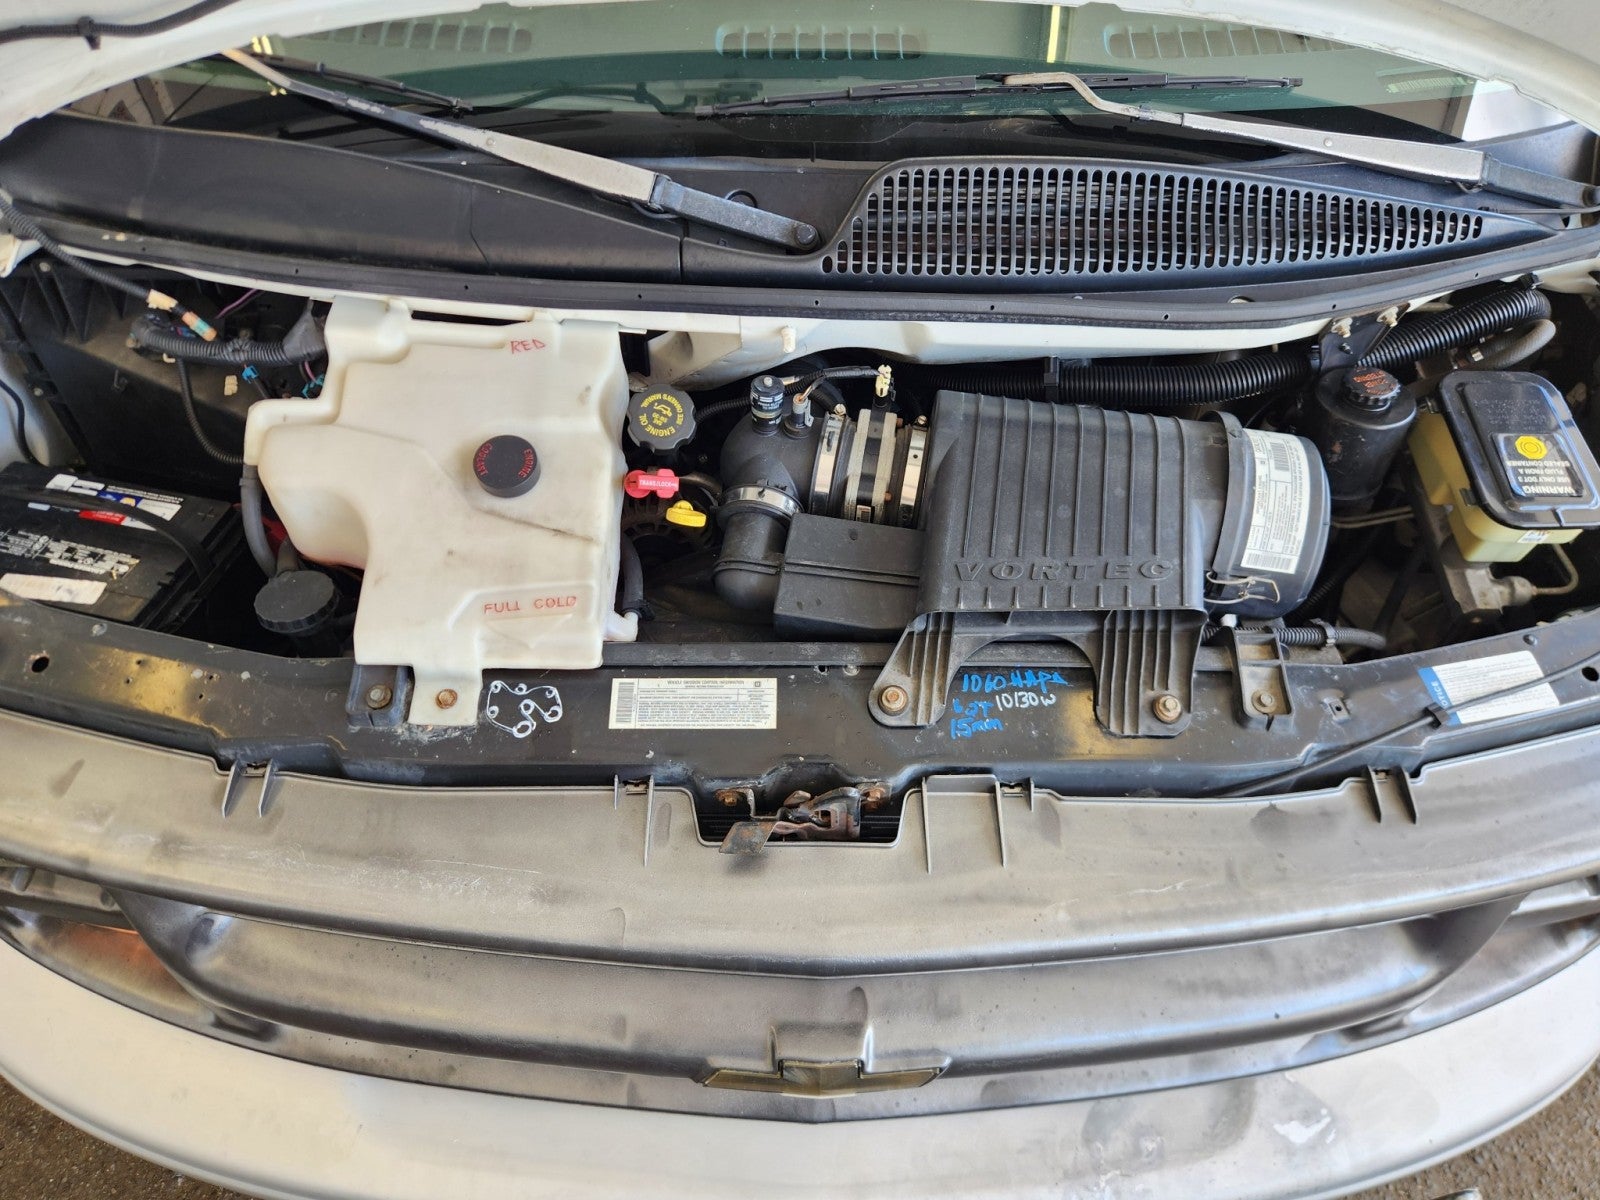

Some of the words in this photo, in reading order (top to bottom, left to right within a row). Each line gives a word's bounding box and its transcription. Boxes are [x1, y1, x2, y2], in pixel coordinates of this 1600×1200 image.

[510, 338, 547, 354] RED
[639, 413, 649, 426] OIL
[645, 424, 676, 437] ENGINE
[476, 442, 492, 476] COOLANT
[518, 448, 534, 478] ENGINE
[1522, 485, 1576, 495] WARNING
[954, 560, 1174, 581] VORTEC
[484, 601, 520, 614] FULL
[533, 596, 577, 609] COLD
[962, 673, 1007, 693] 1060
[1431, 681, 1448, 708] OTICE
